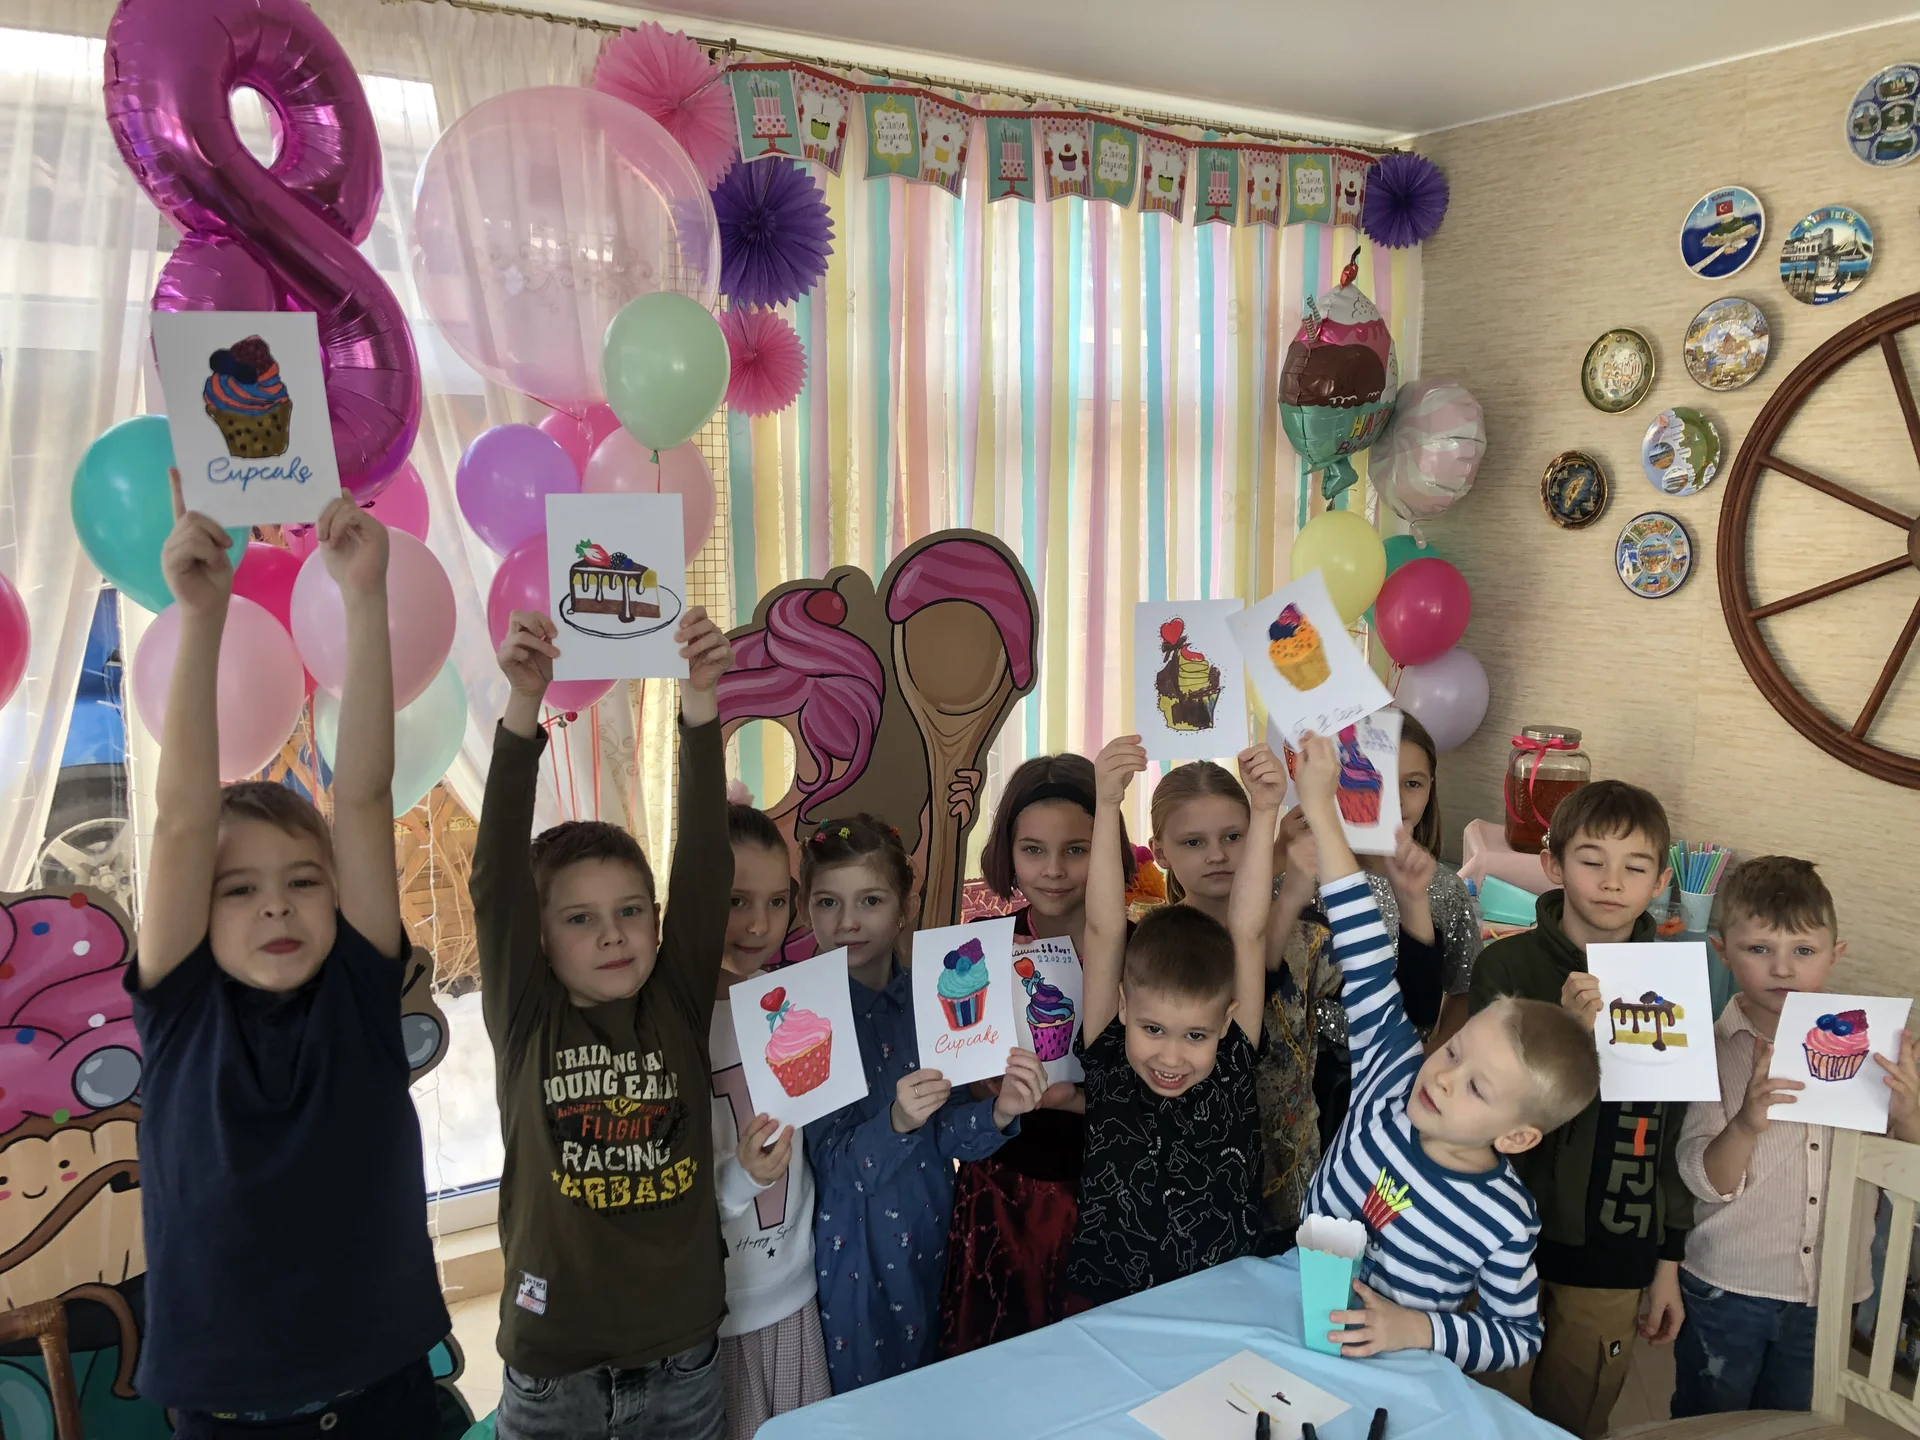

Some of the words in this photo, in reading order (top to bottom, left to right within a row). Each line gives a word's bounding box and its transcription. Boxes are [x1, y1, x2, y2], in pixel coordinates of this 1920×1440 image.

[1349, 408, 1391, 441] HAPP
[208, 456, 314, 491] Cupcake
[934, 1024, 1000, 1058] Cupcake
[556, 1044, 637, 1074] TRAINNG
[581, 1114, 652, 1142] FLIGHT
[562, 1138, 671, 1173] RACING
[735, 1235, 772, 1252] Happy
